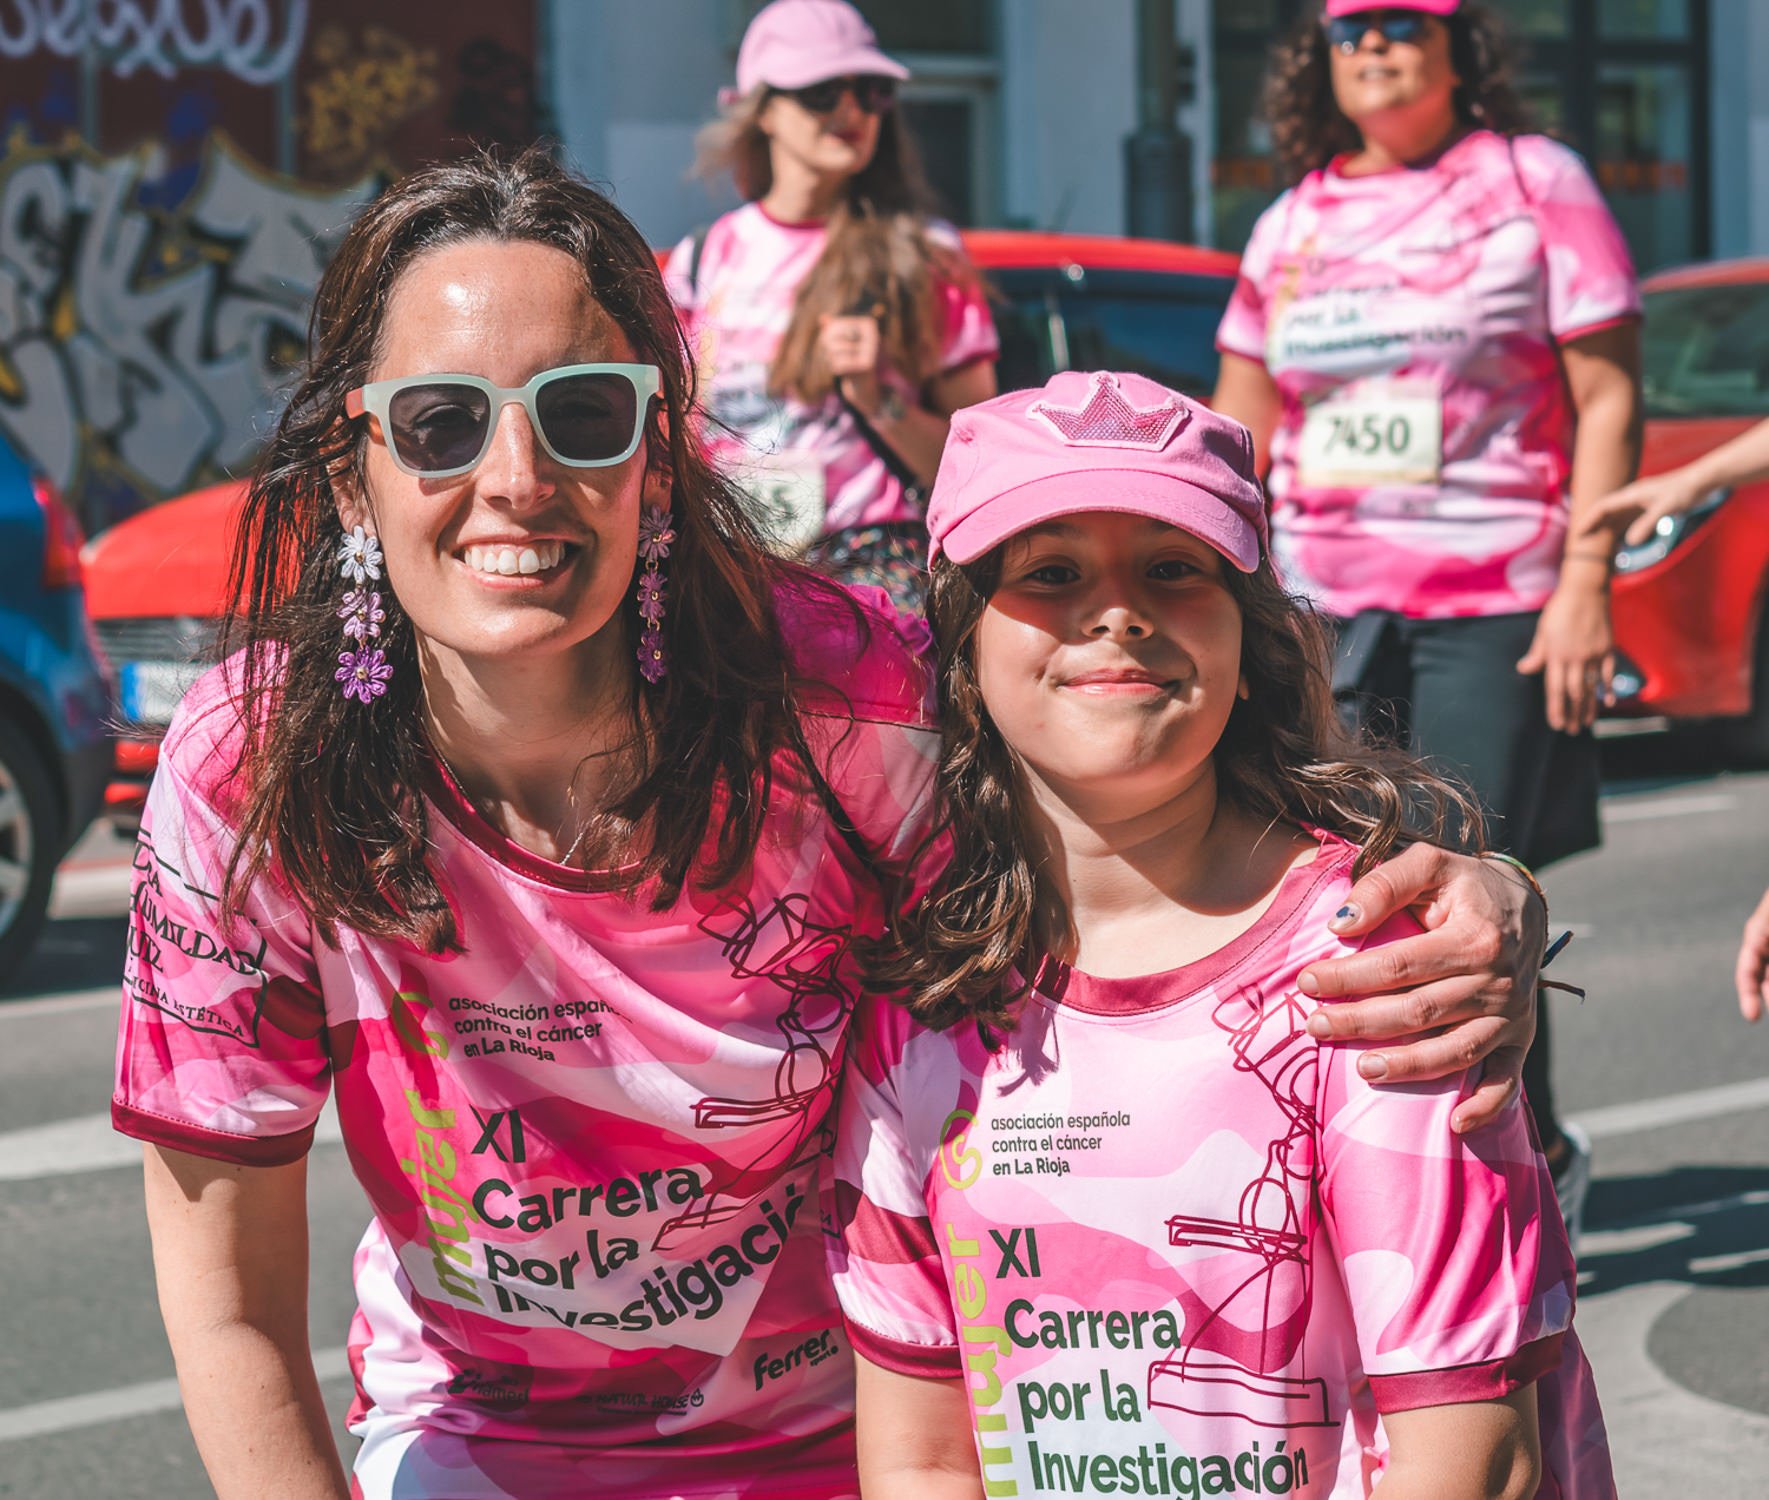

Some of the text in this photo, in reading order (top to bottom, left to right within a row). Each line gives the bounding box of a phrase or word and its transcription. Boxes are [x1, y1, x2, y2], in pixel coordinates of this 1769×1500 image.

[1323, 414, 1412, 456] 7450
[449, 997, 549, 1021] asociación
[454, 1016, 603, 1043] contra el cáncer
[463, 1037, 556, 1062] en La Rioja
[470, 1103, 527, 1164] XI
[991, 1110, 1131, 1132] asociación española
[992, 1134, 1103, 1153] contra el cáncer
[992, 1156, 1071, 1177] en La Rioja
[472, 1167, 705, 1234] Carrera
[483, 1229, 640, 1290] por la
[988, 1227, 1042, 1279] XI
[1004, 1298, 1181, 1350] Carrera
[1017, 1368, 1142, 1434] por la
[1027, 1440, 1310, 1500] Investigación
